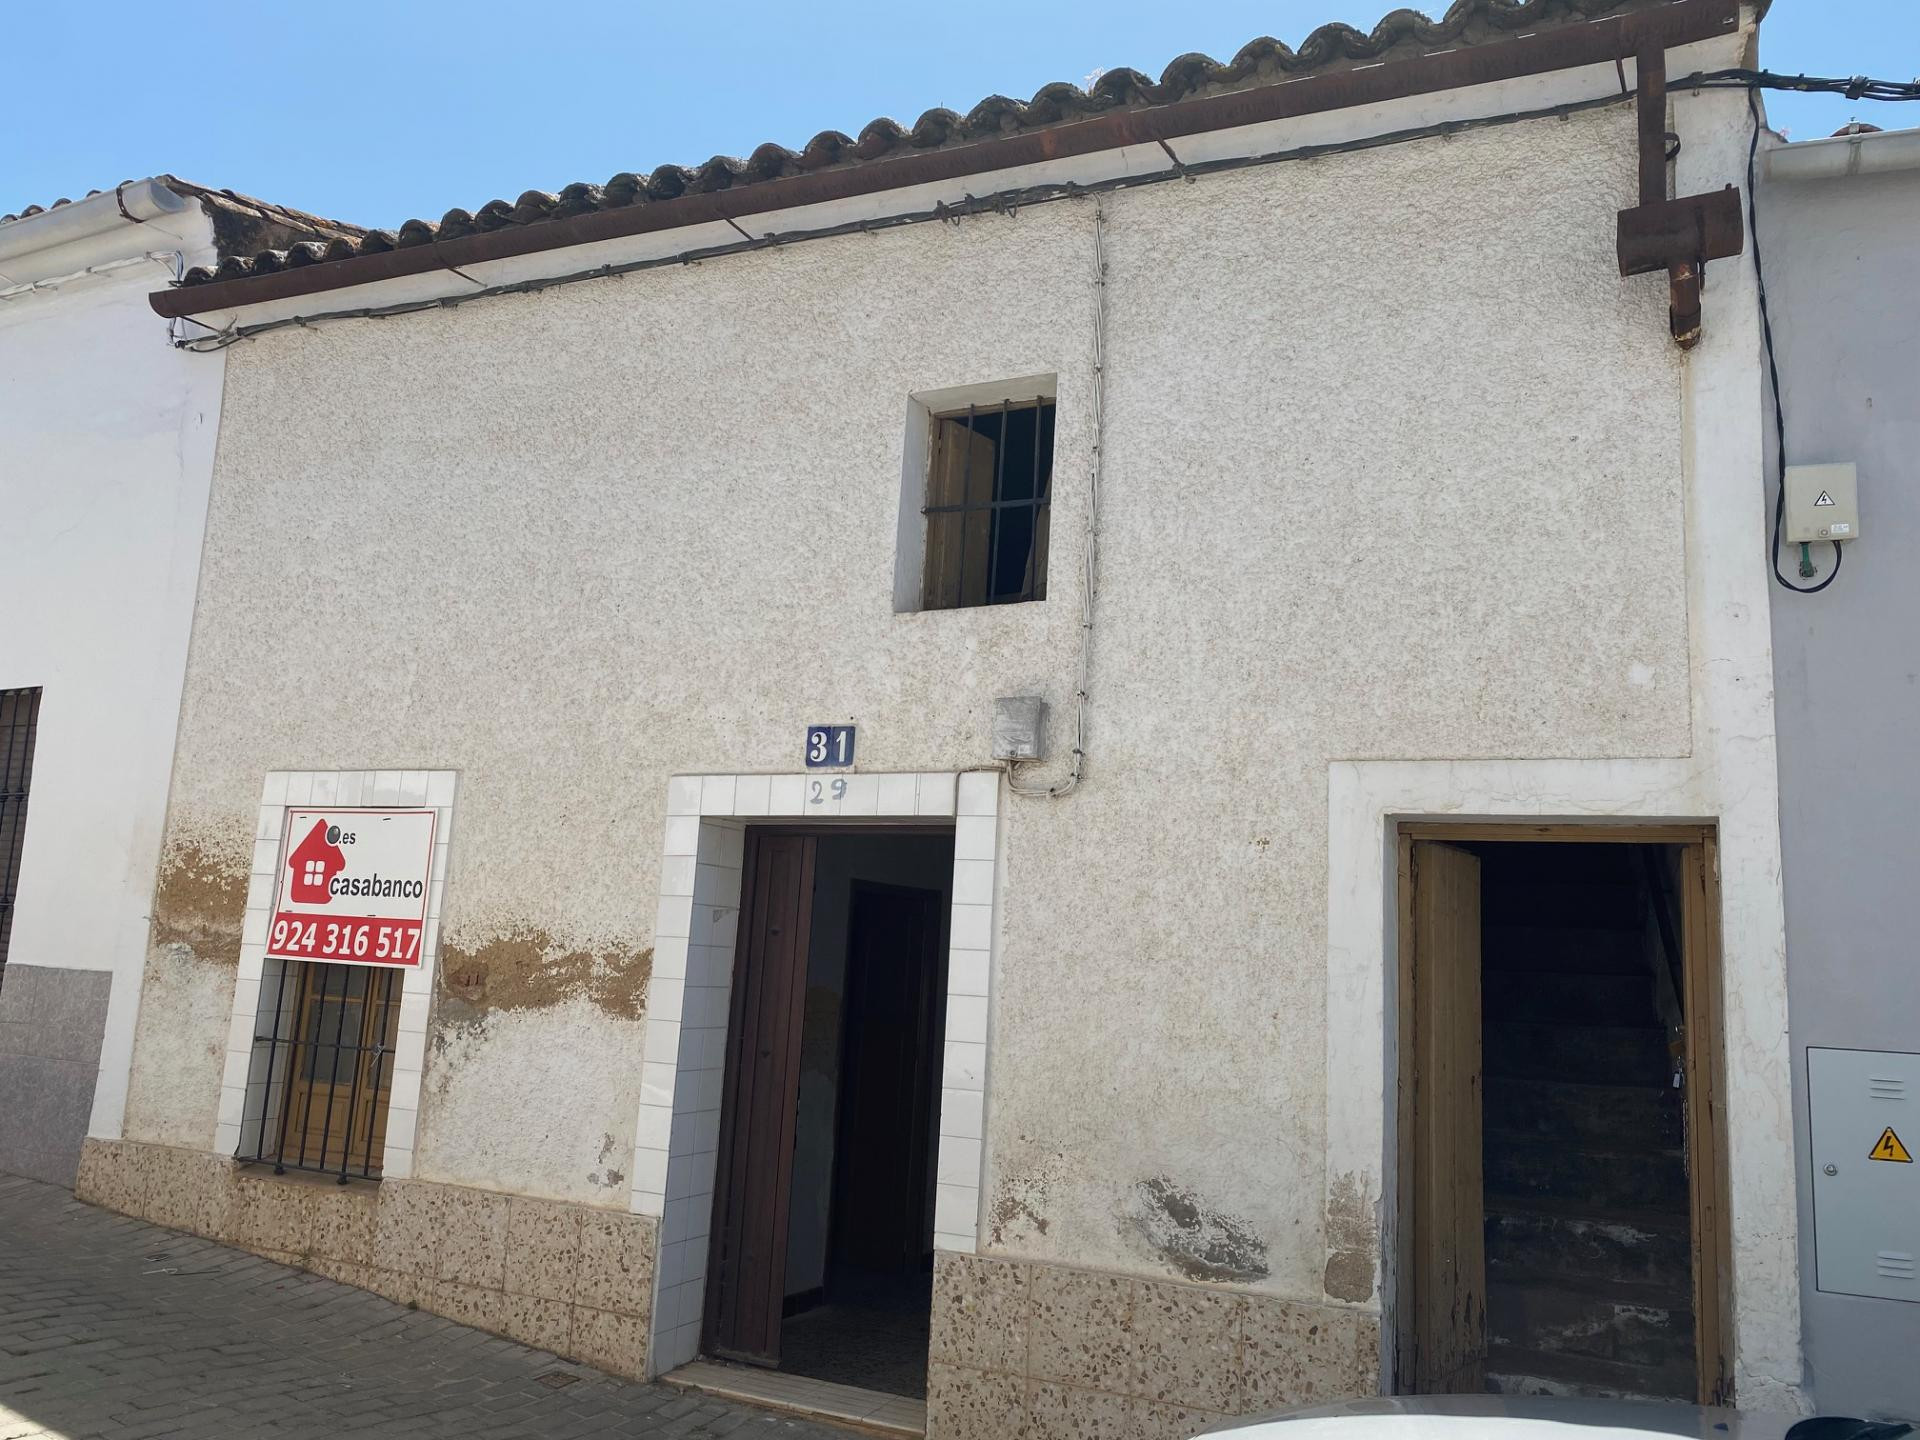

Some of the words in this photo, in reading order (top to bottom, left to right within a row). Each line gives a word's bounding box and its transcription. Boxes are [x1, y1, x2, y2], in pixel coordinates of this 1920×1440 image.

[810, 731, 847, 762] 31
[810, 778, 847, 805] 29
[329, 873, 423, 899] casabanco
[271, 920, 318, 952] 924
[322, 923, 370, 956] 316
[375, 926, 421, 960] 517
